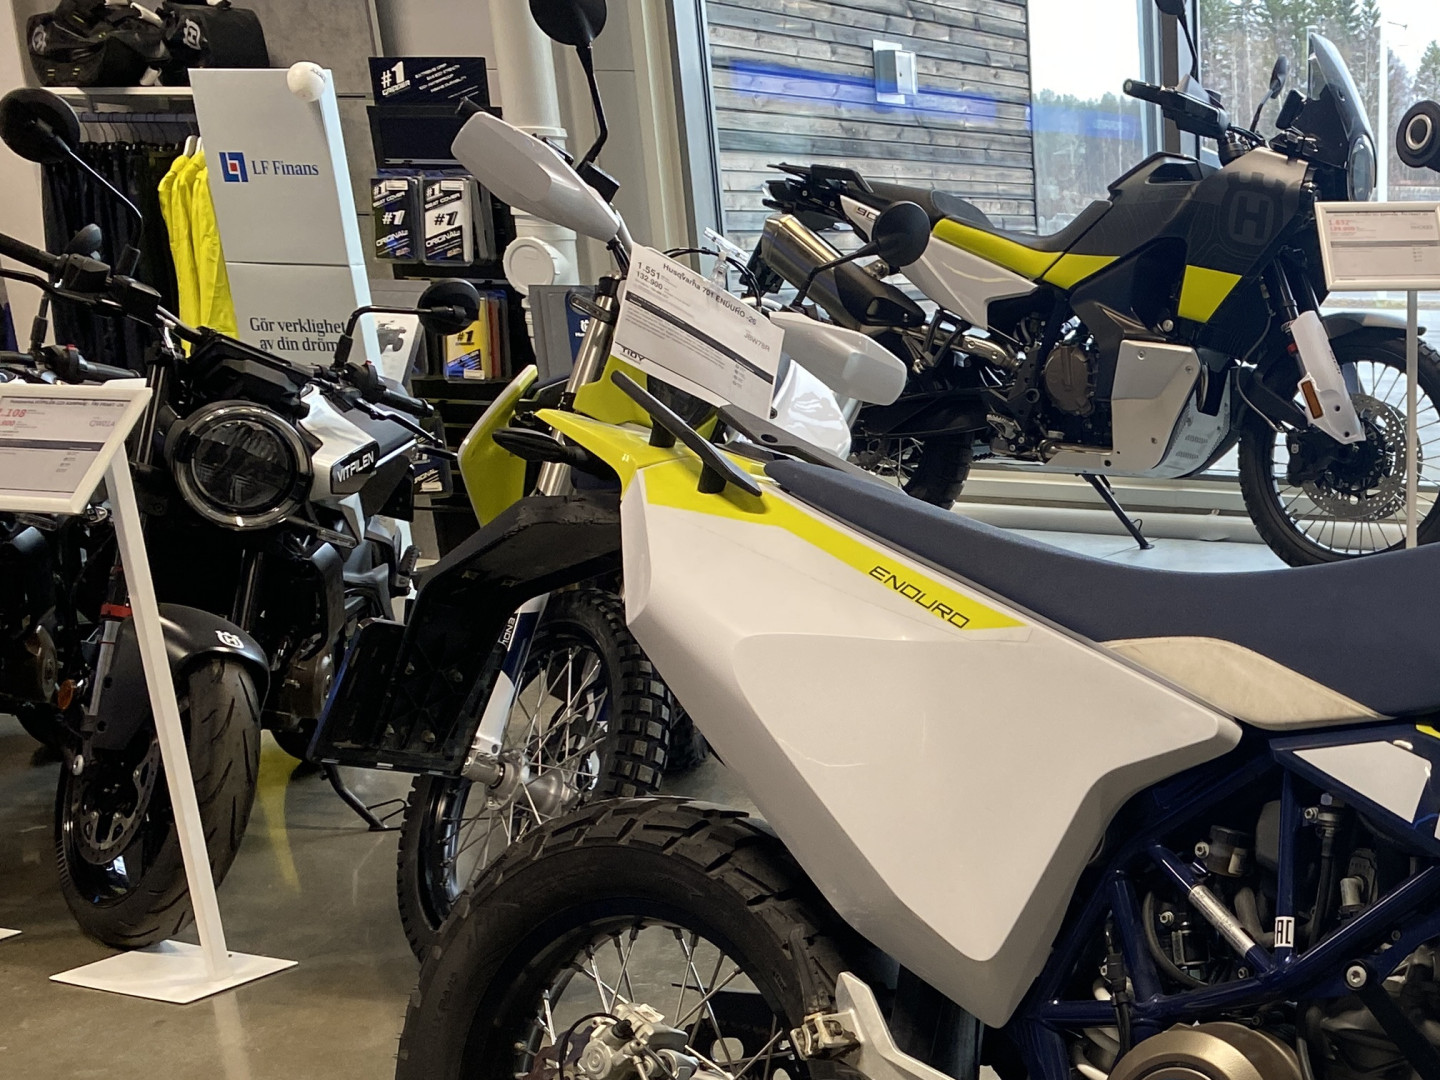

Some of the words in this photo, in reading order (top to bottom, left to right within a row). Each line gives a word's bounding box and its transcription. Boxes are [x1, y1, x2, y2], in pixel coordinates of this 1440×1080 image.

[251, 160, 269, 175] LF
[272, 160, 319, 176] Finans
[382, 210, 406, 225] #1
[434, 211, 458, 226] #1
[663, 262, 701, 291] Husqvarna
[715, 295, 746, 318] ENDURO
[249, 317, 275, 332] Gör
[277, 318, 346, 337] verklighet
[259, 339, 274, 352] av
[277, 336, 300, 351] din
[302, 337, 340, 352] dröm
[337, 451, 375, 482] VITPILEN
[869, 565, 970, 629] ENDURO
